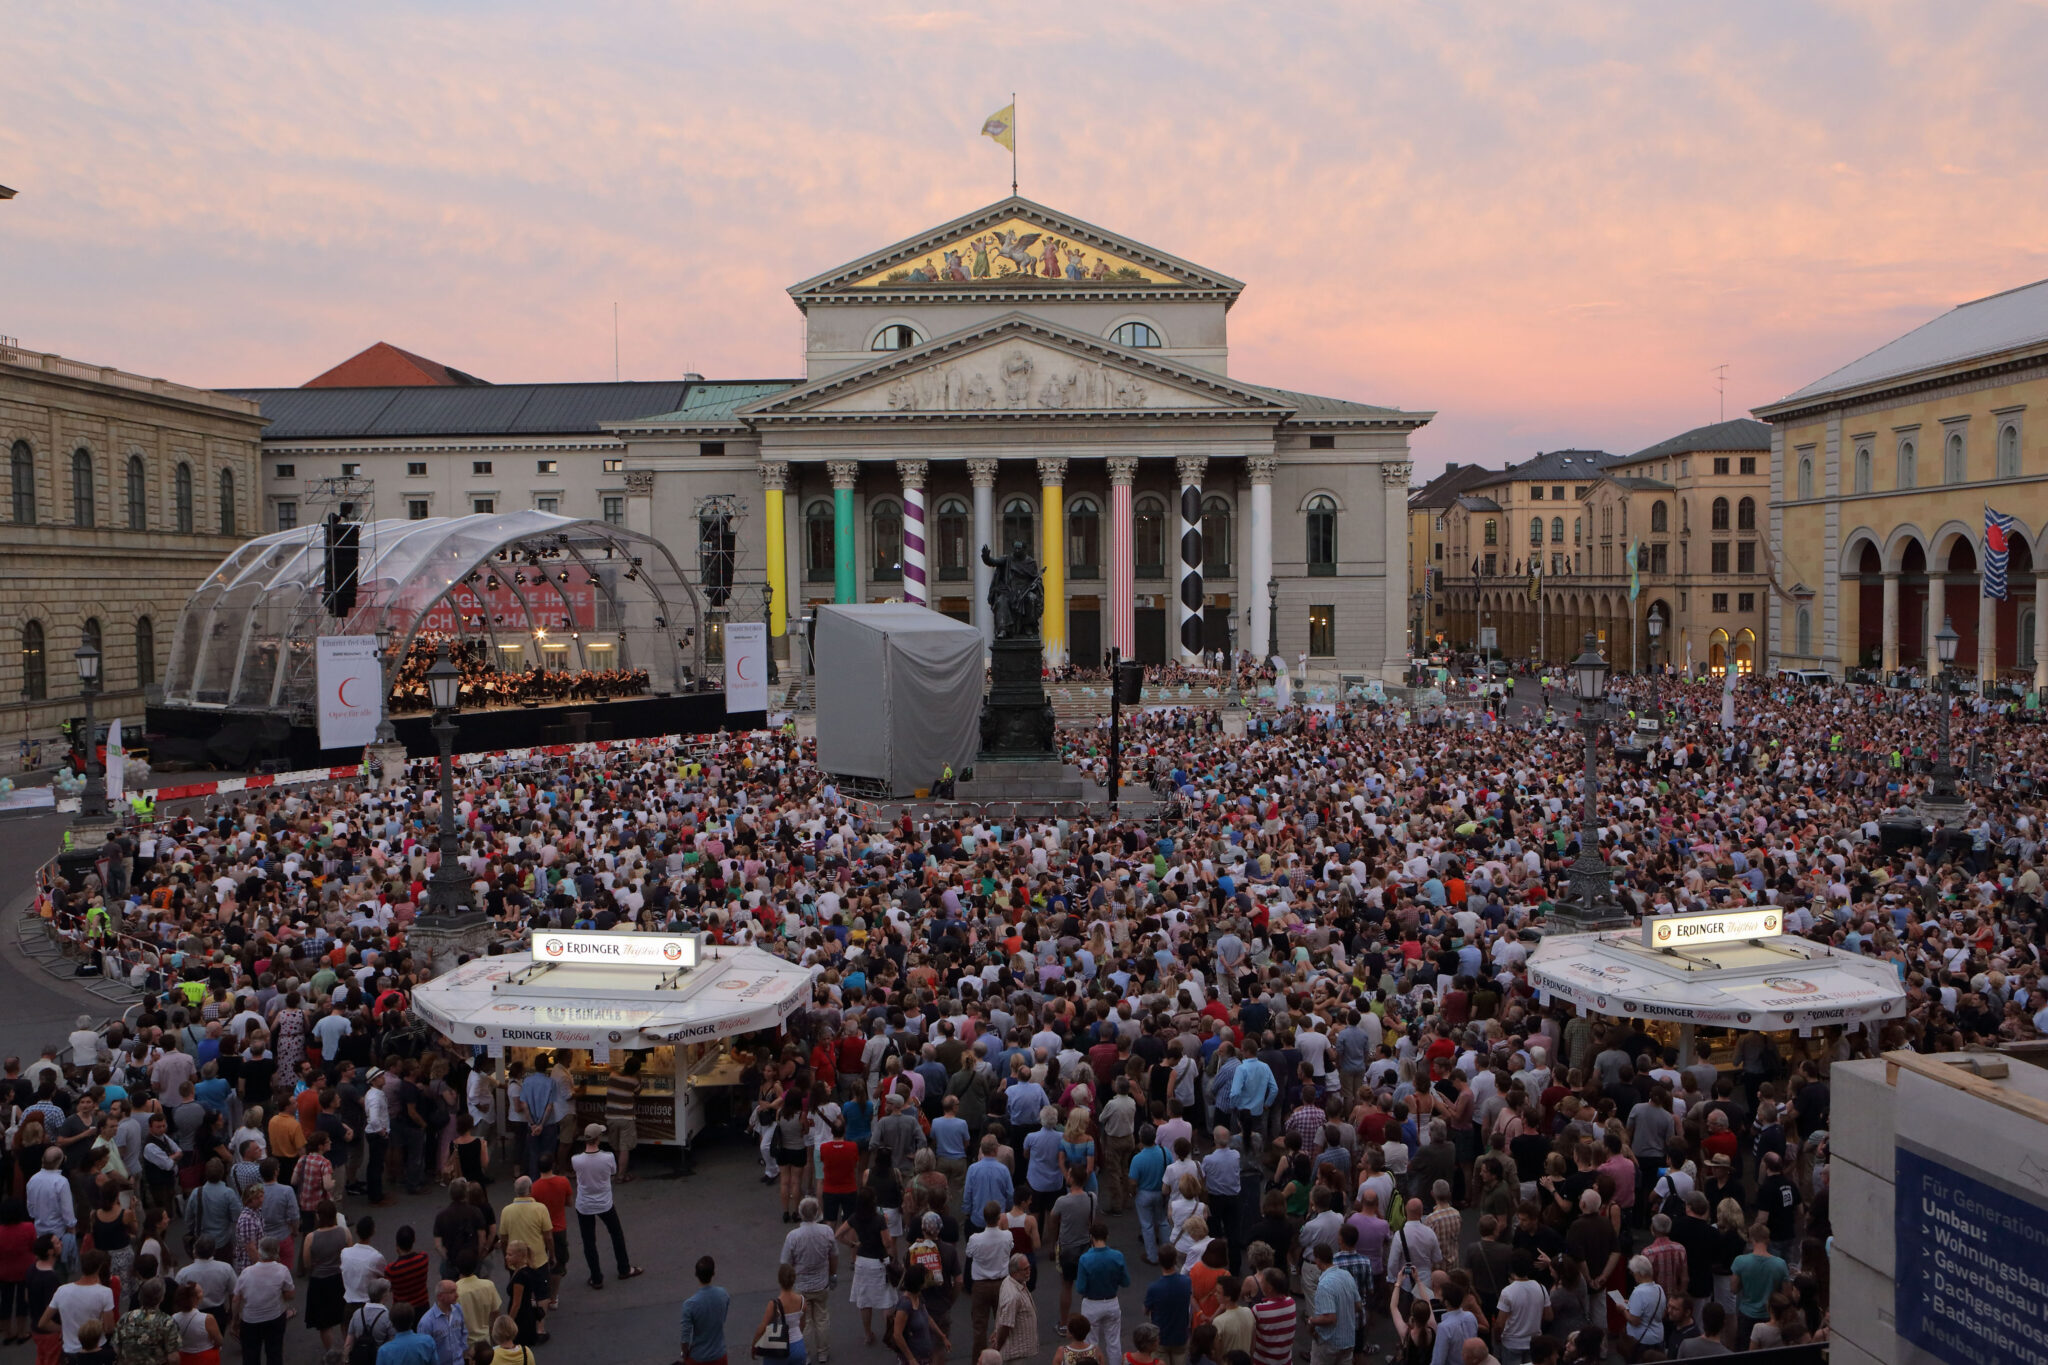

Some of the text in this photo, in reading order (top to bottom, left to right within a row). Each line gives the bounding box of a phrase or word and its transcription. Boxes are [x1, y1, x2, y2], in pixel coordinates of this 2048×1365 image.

[545, 592, 586, 607] IHRE
[1677, 922, 1724, 938] ERDINGER
[567, 941, 620, 956] ERDINGER
[1542, 976, 1573, 998] ERDINGER
[1643, 1003, 1694, 1019] ERDINGER
[502, 1028, 591, 1043] ERDINGER Weißbier
[668, 1024, 715, 1042] ERDINGER
[1922, 1174, 1950, 1200] Für
[1921, 1196, 1988, 1243] Umbau:
[1934, 1249, 2038, 1316] Gewerbebau
[1921, 1316, 1985, 1365] Neubau
